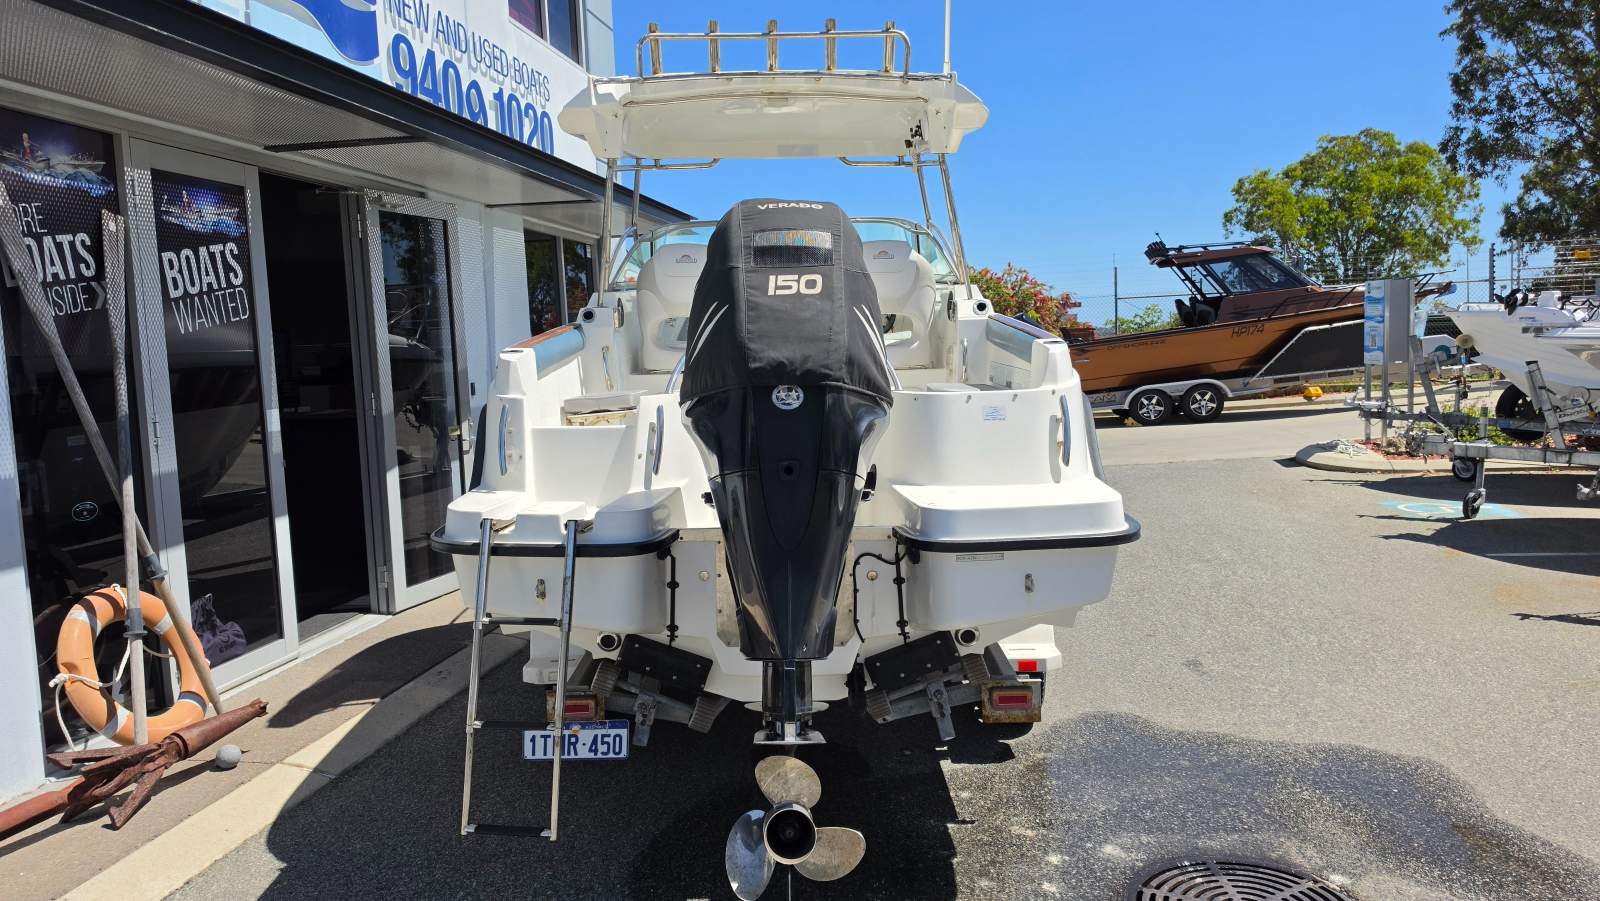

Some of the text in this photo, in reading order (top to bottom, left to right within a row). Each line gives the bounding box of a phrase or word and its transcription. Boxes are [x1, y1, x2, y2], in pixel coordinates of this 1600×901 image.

[435, 10, 468, 54] AND
[472, 31, 509, 78] USED
[512, 56, 551, 102] BOATS
[391, 33, 555, 157] 9409 1020
[11, 203, 48, 233] ORE
[757, 202, 824, 210] VERADO
[2, 232, 96, 288] OATS
[161, 242, 244, 299] BOATS
[47, 282, 92, 317] NSIDE
[767, 273, 823, 296] 150
[172, 287, 250, 335] WANTED
